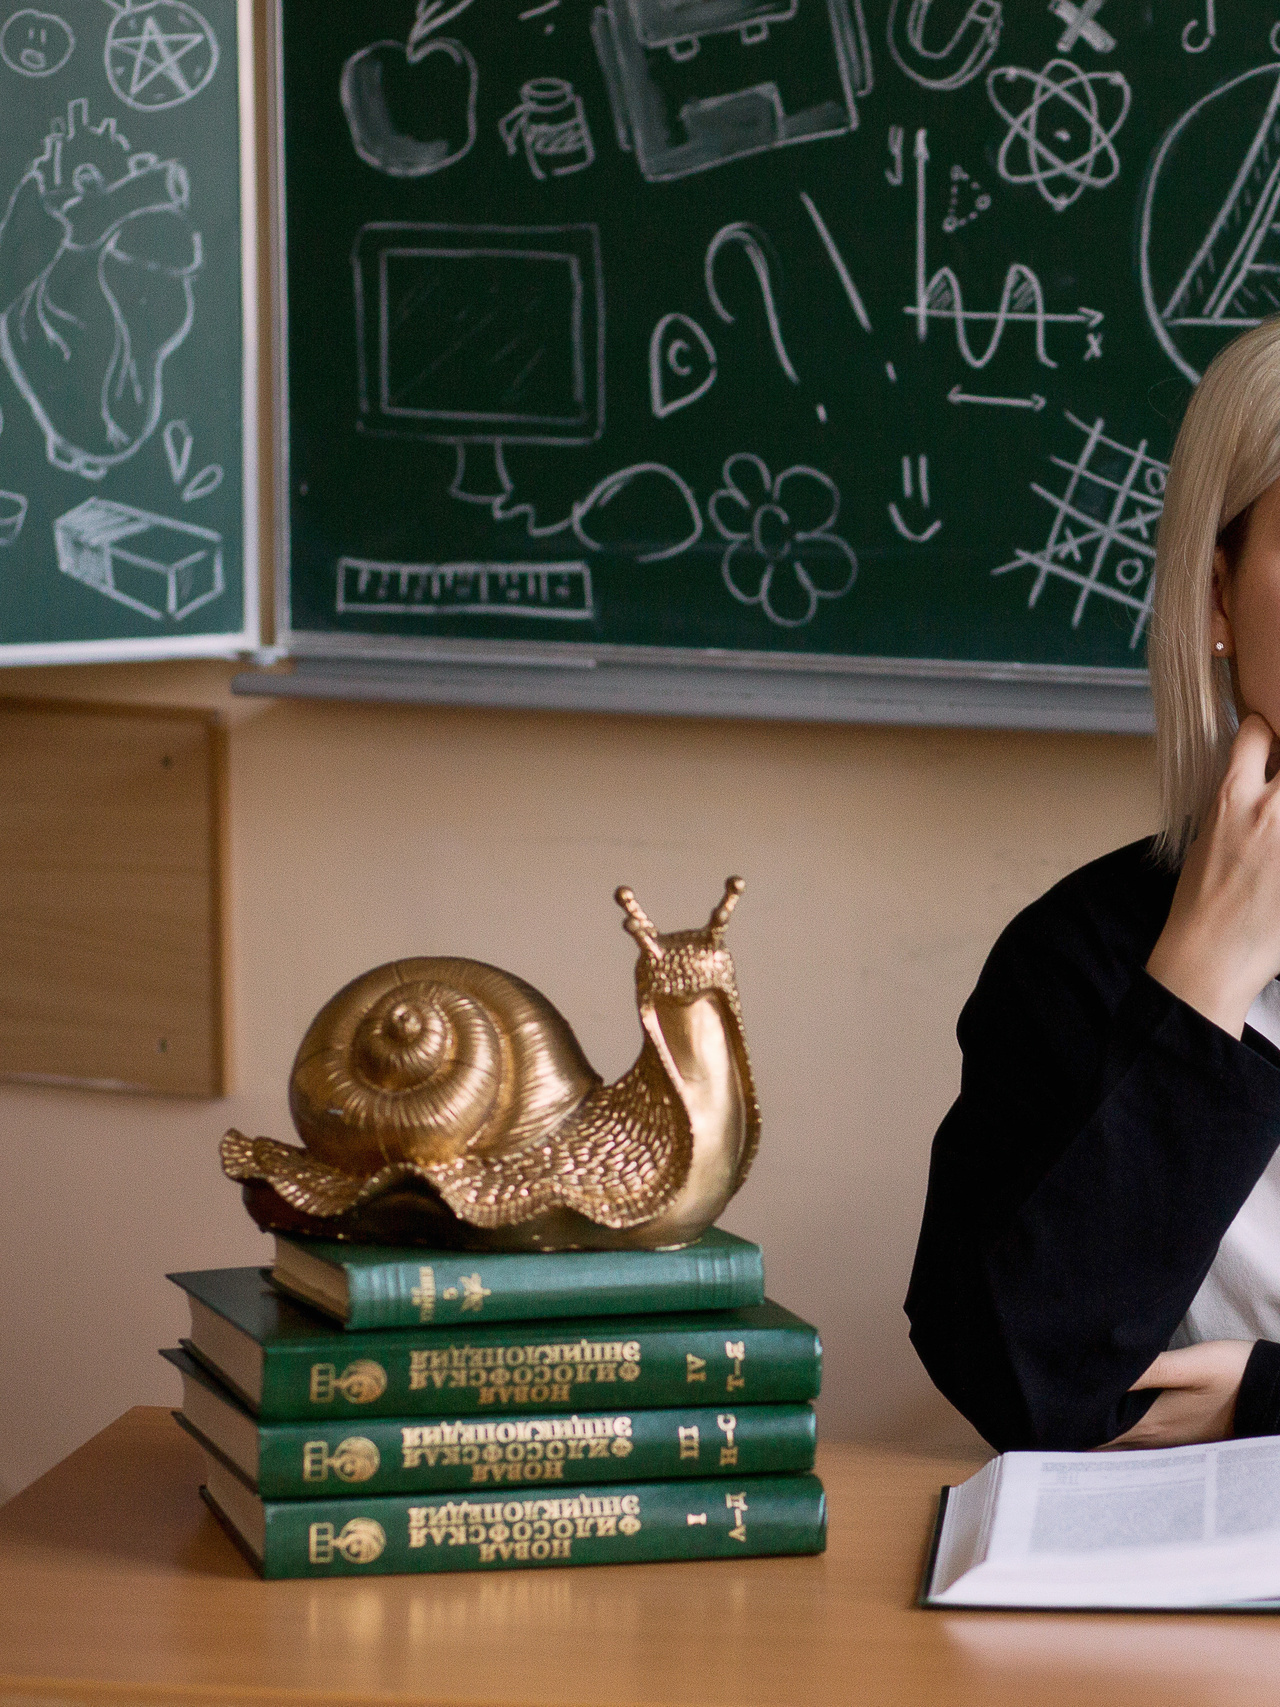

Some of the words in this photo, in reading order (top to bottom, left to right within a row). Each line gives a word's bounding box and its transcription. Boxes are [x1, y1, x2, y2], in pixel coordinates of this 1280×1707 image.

[410, 1339, 641, 1370] ЭНЦИКЛОПЕДИЯ
[686, 1352, 707, 1382] IV
[408, 1361, 641, 1390] ФИЛОСОФСКАЯ
[477, 1382, 571, 1405] НОВАЯ
[400, 1414, 633, 1446] ЭНЦИКЛОПЕДИЯ
[678, 1425, 700, 1460] III
[401, 1437, 634, 1468] ФИЛОСОФСКАЯ
[470, 1460, 565, 1483] НОВАЯ
[407, 1493, 641, 1526] ЭНЦИКЛОПЕДИЯ
[686, 1512, 707, 1526] I
[408, 1514, 643, 1548] ФИЛОСОФСКАЯ
[478, 1538, 572, 1562] НОВАЯ
